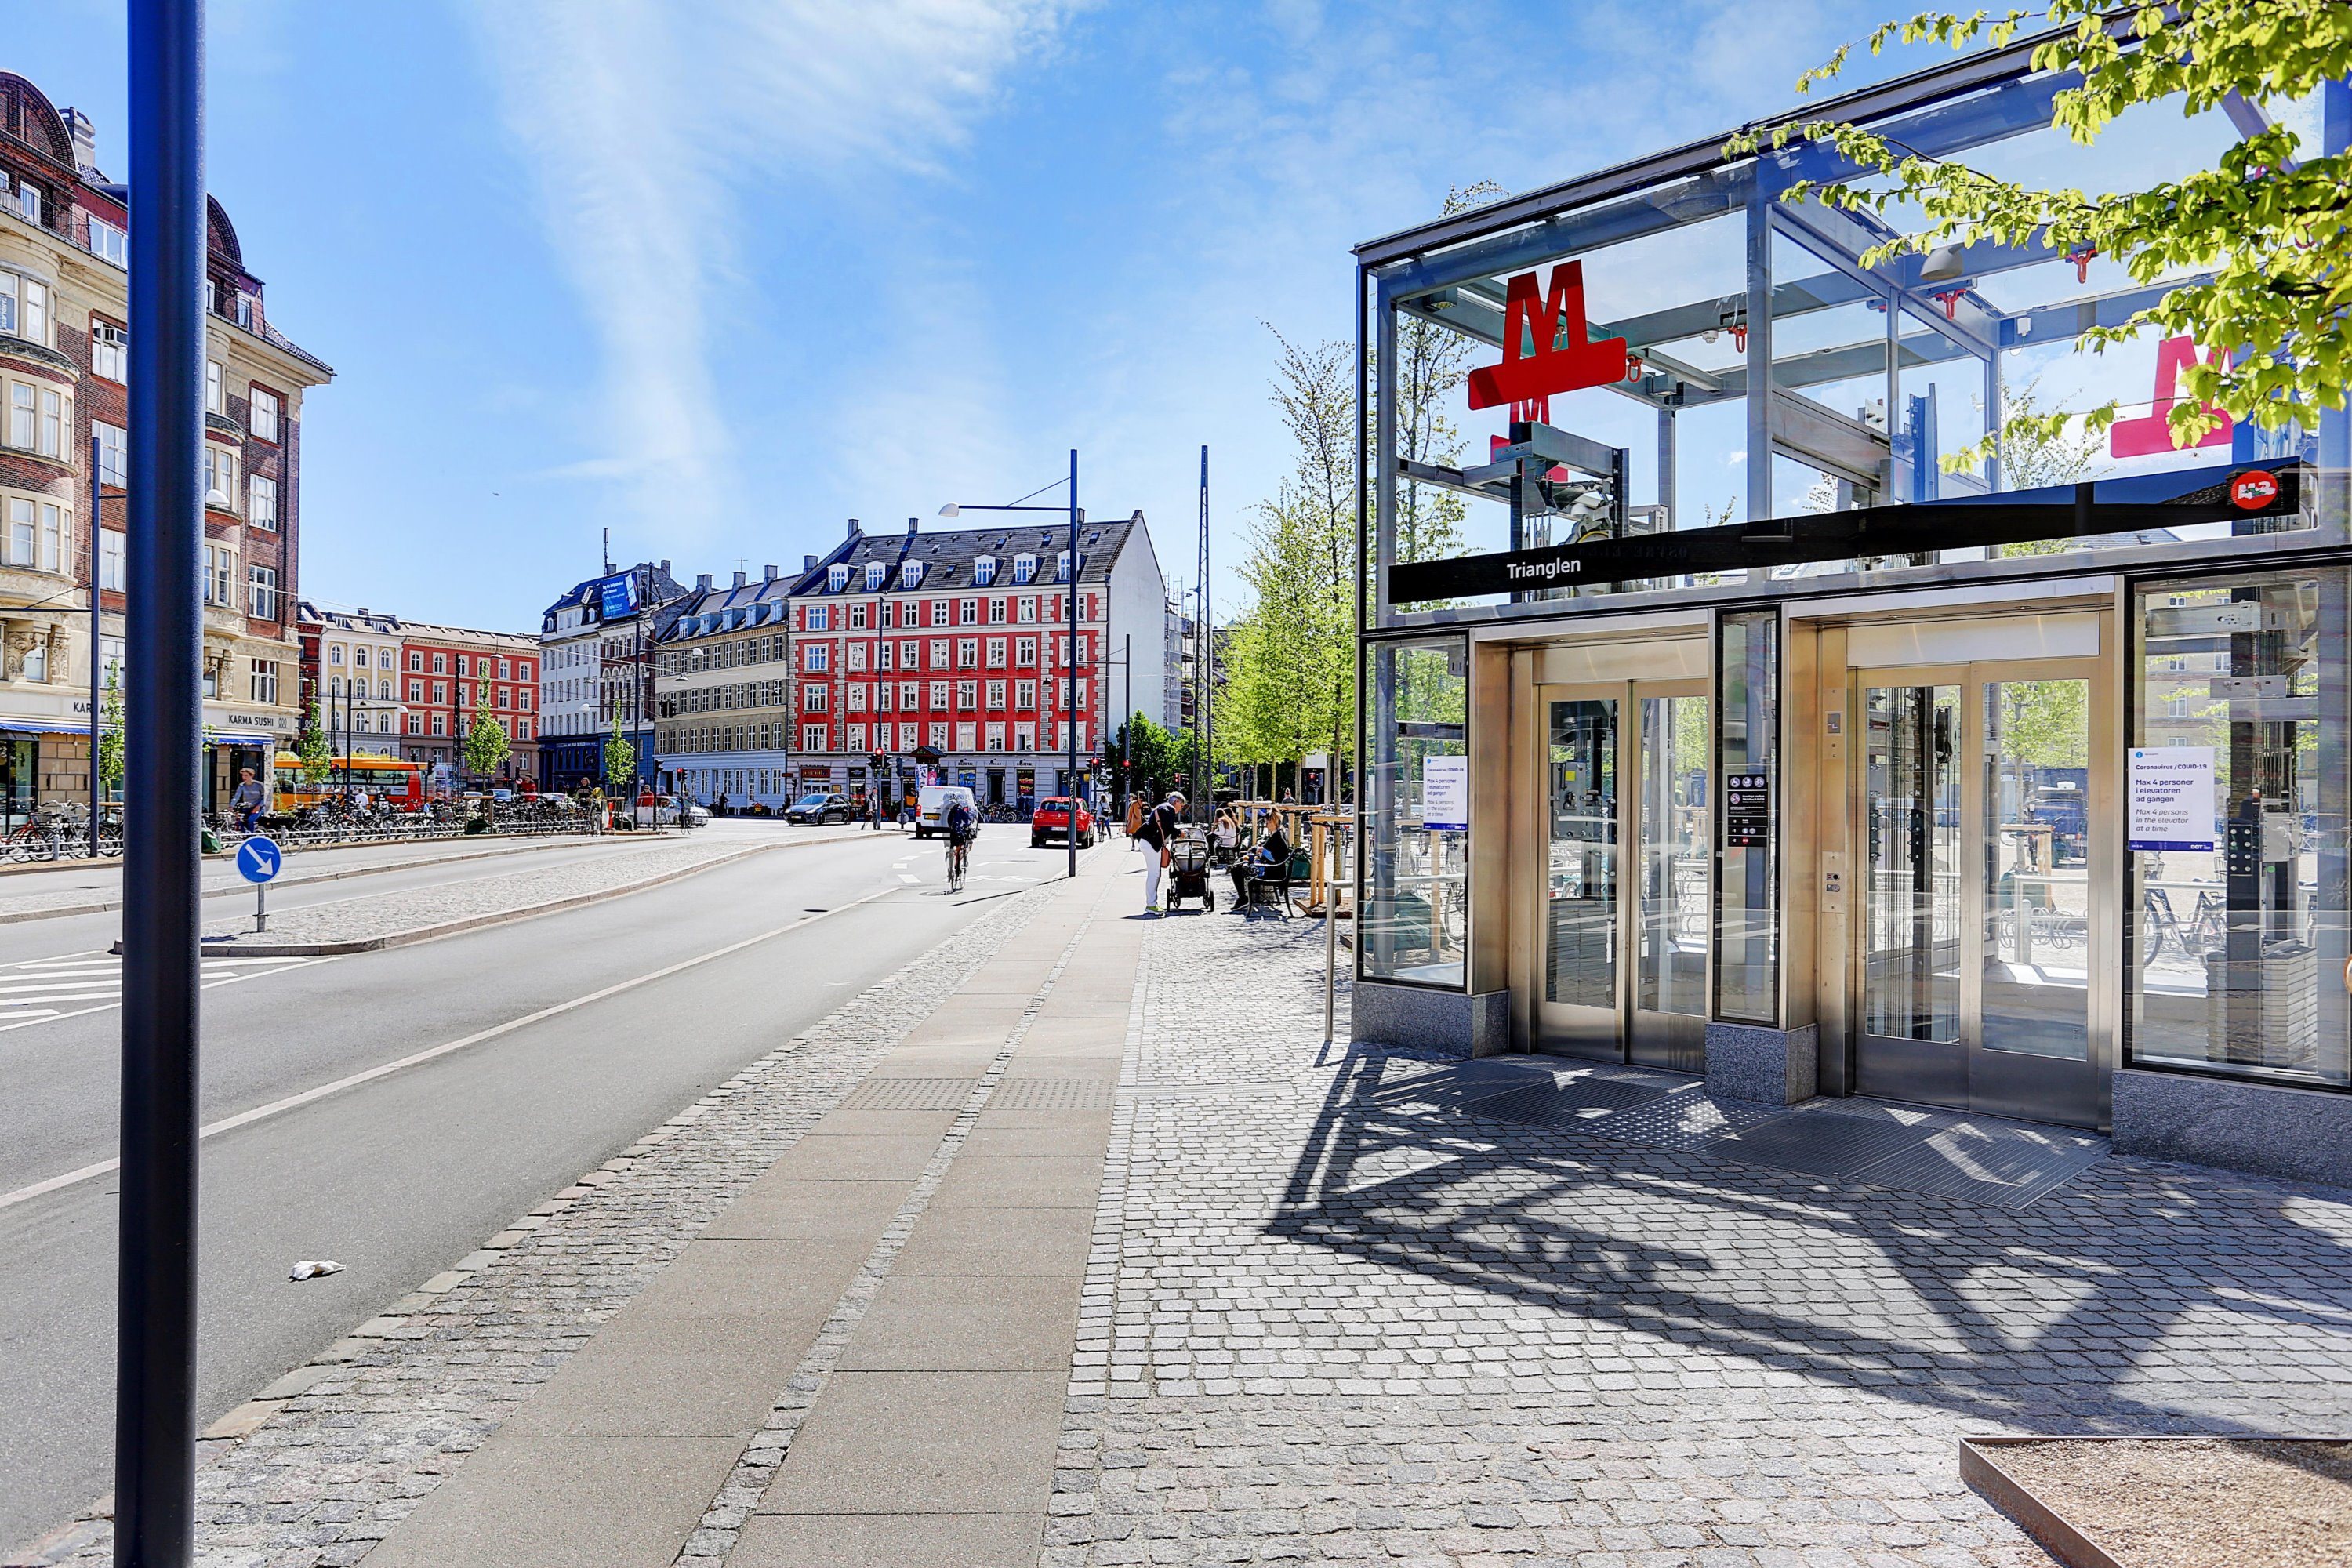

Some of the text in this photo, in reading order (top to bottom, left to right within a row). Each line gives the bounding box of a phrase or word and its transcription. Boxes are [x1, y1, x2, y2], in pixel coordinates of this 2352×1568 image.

[1506, 557, 1581, 579] Trianglen
[73, 702, 106, 715] KARA
[228, 714, 274, 727] KARMA SUSHI
